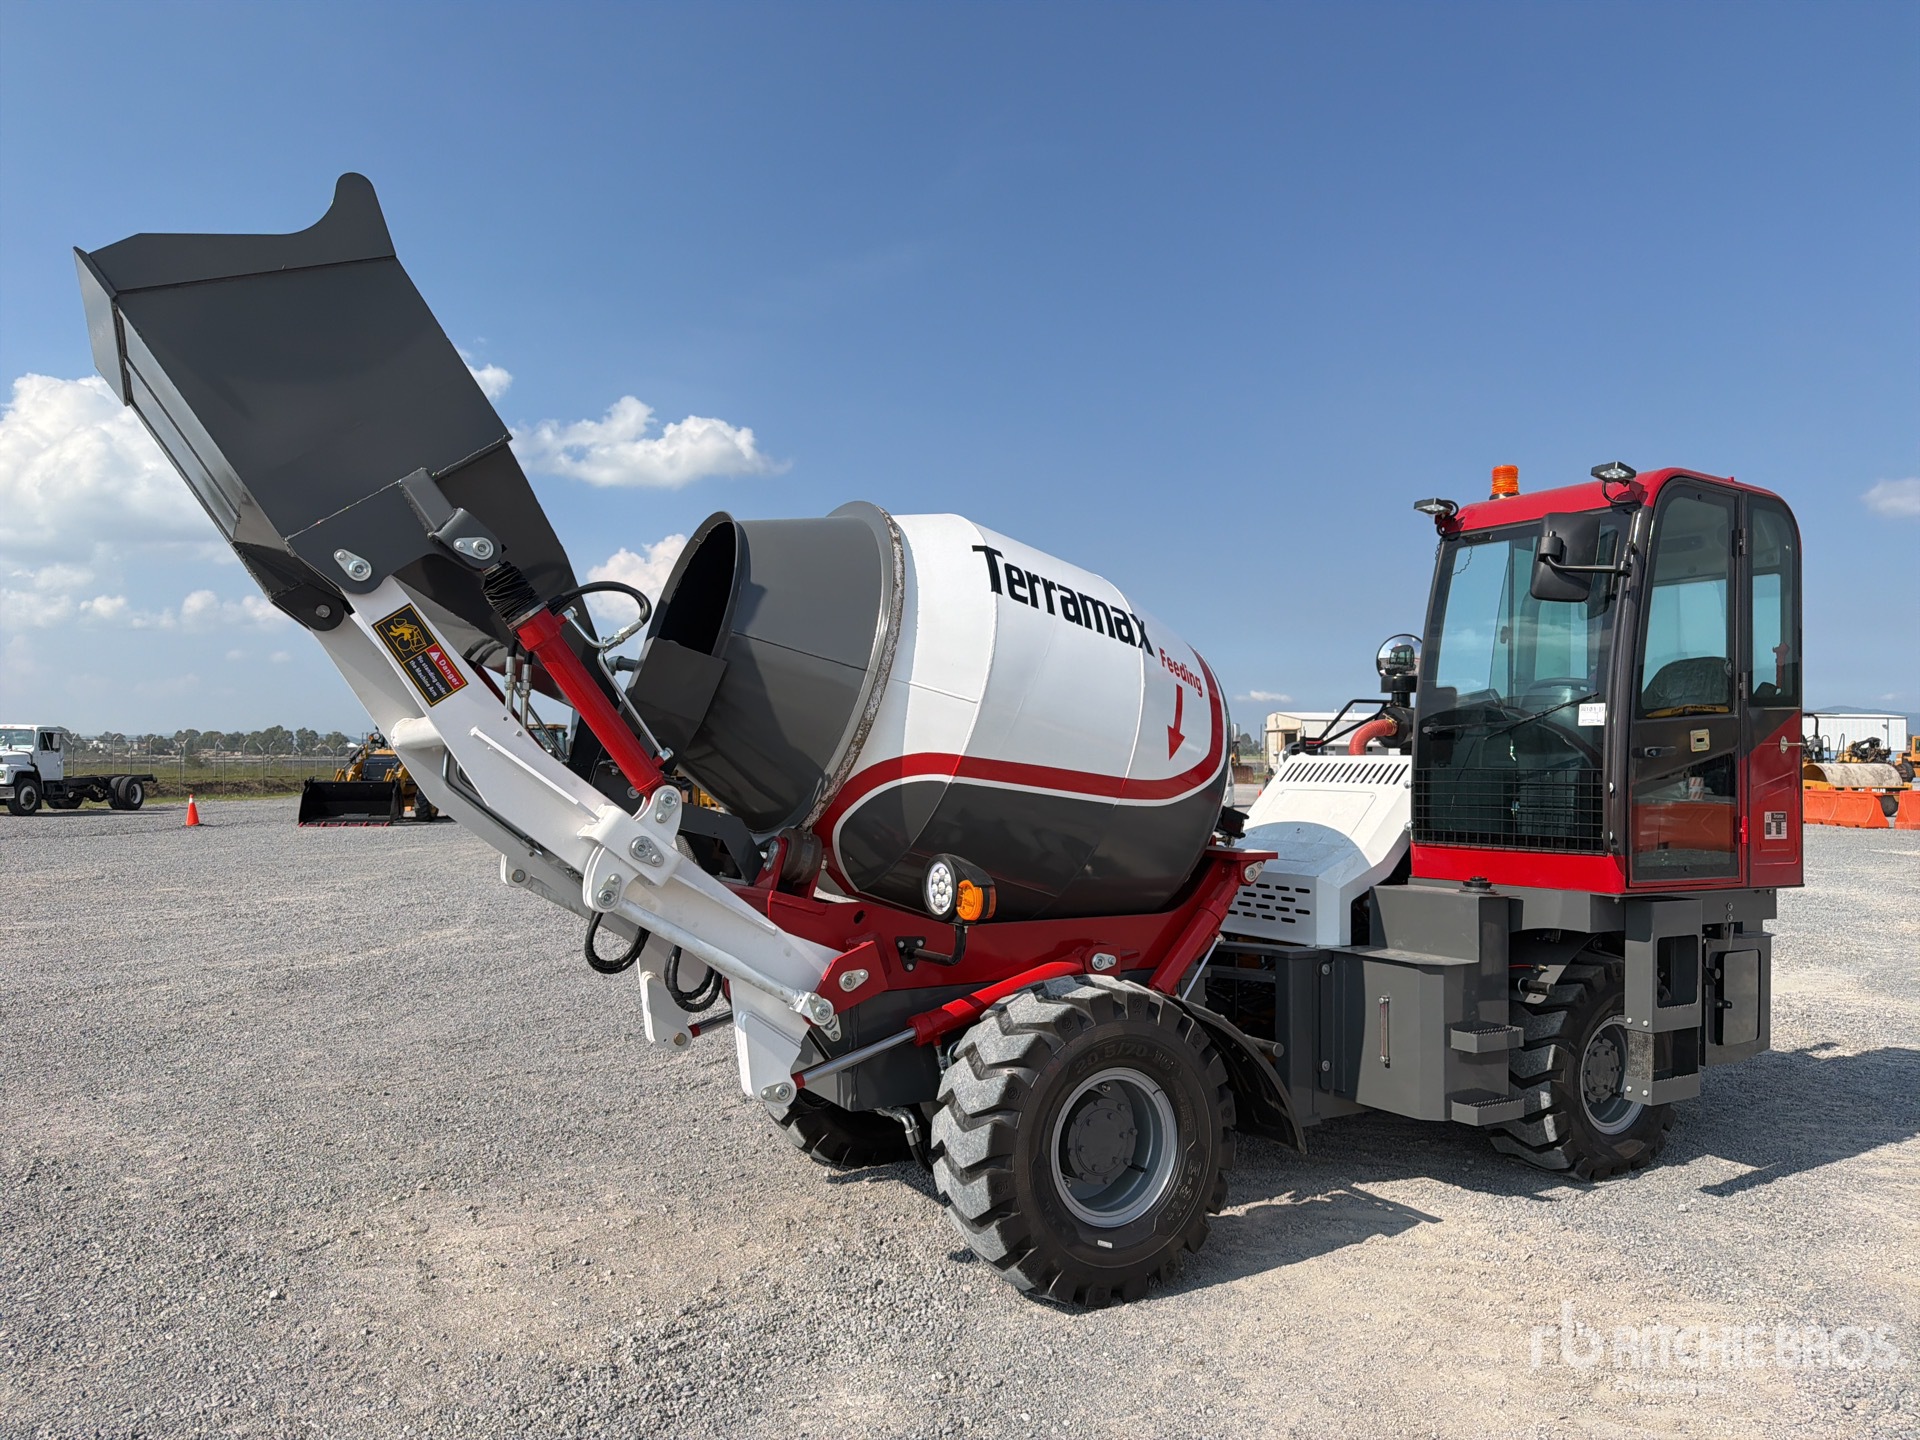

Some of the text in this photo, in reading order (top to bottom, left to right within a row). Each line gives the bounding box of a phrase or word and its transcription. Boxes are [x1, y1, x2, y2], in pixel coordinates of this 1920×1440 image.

[972, 545, 1155, 658] Terramax
[409, 660, 438, 697] the Machine Arm
[416, 655, 447, 695] No standing under
[438, 659, 460, 686] Danger
[1158, 646, 1203, 698] Feeding
